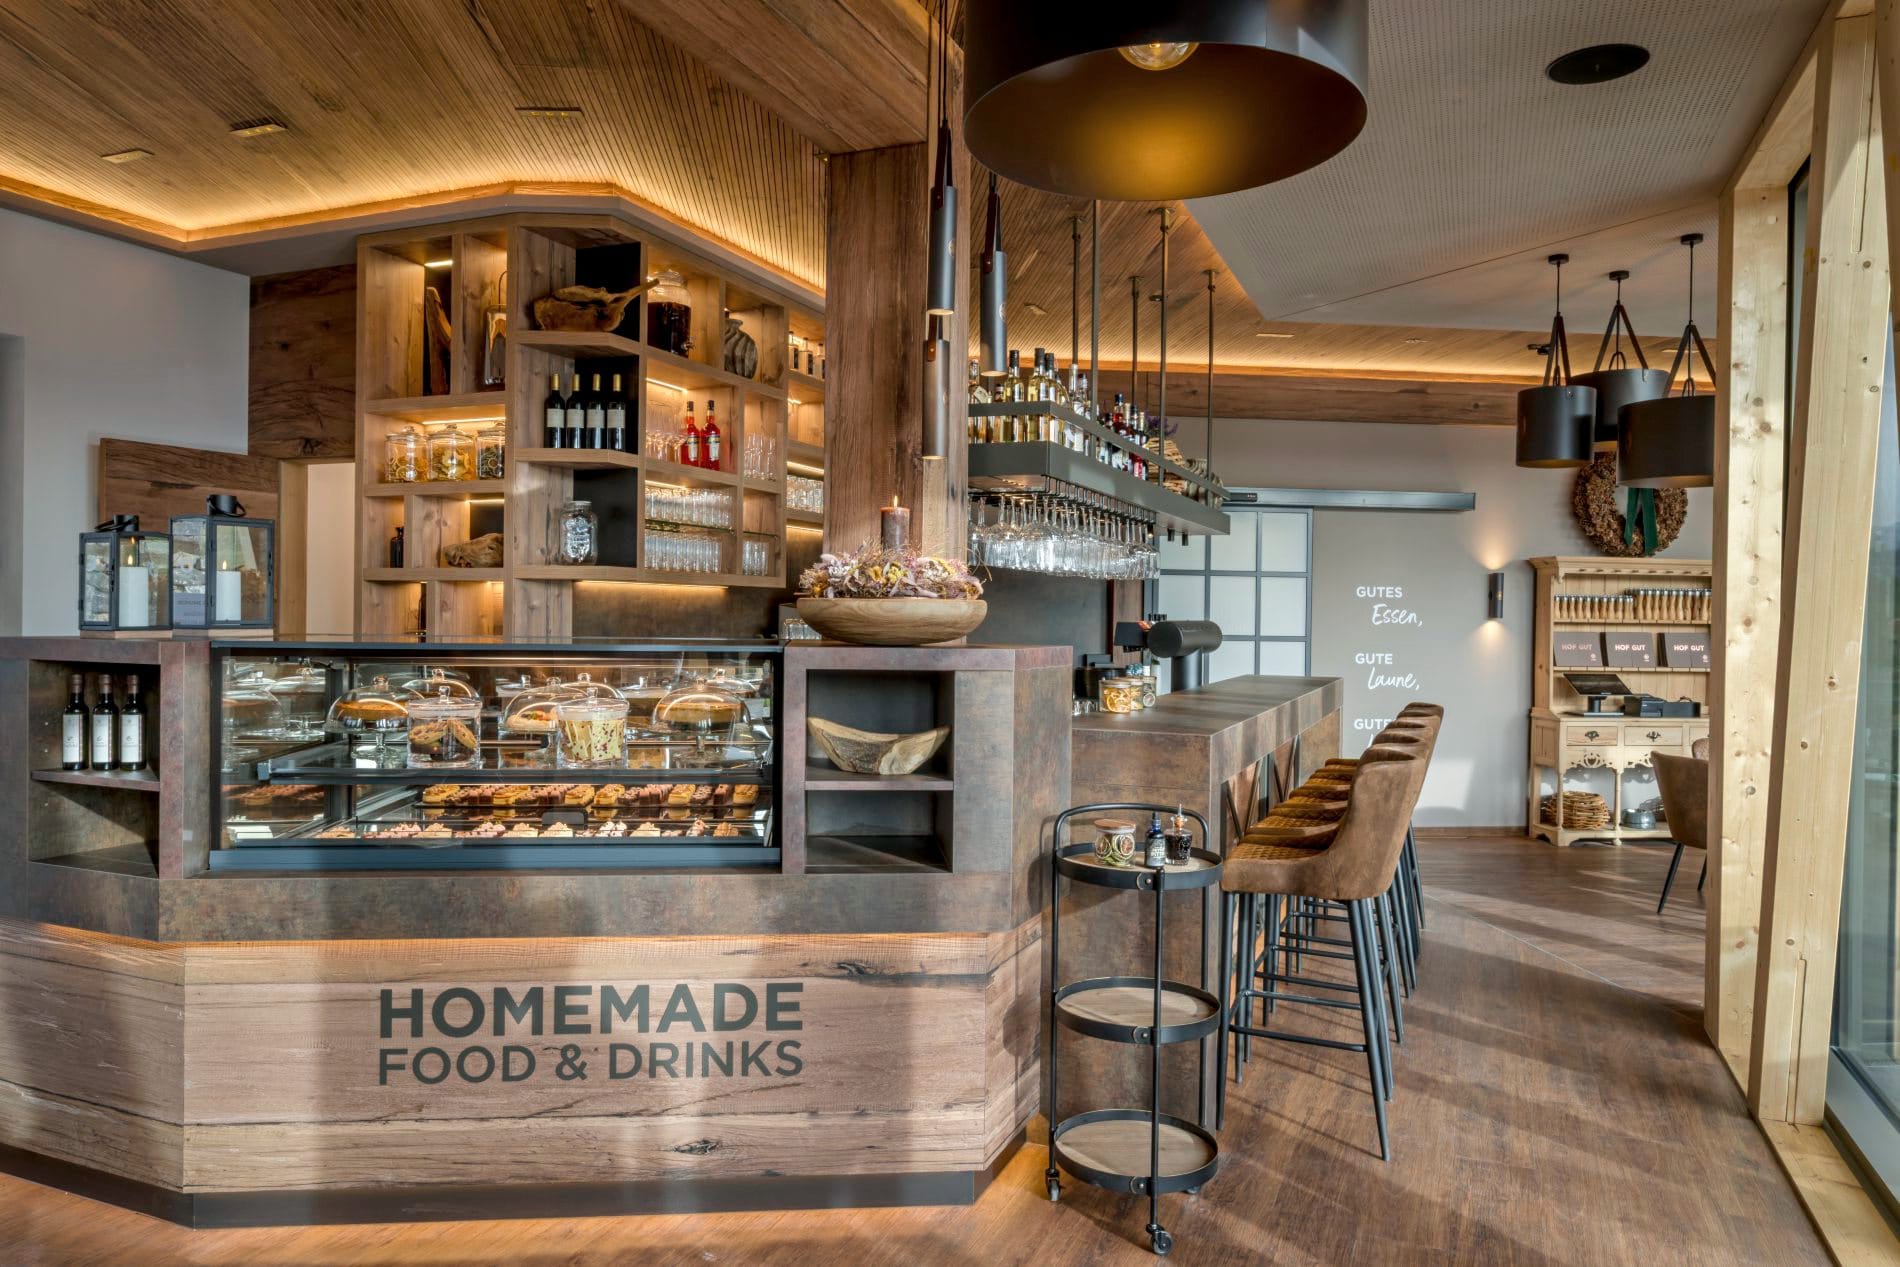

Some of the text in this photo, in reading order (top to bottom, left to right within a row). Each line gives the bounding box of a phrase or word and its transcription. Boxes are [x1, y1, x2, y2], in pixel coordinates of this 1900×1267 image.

[1356, 586, 1403, 598] GUTES
[1372, 603, 1423, 627] Essen,
[1355, 653, 1393, 665] GUTE
[1367, 666, 1420, 691] Laune,
[379, 982, 804, 1039] HOMEMADE
[379, 1040, 804, 1085] FOOD & DRINKS
